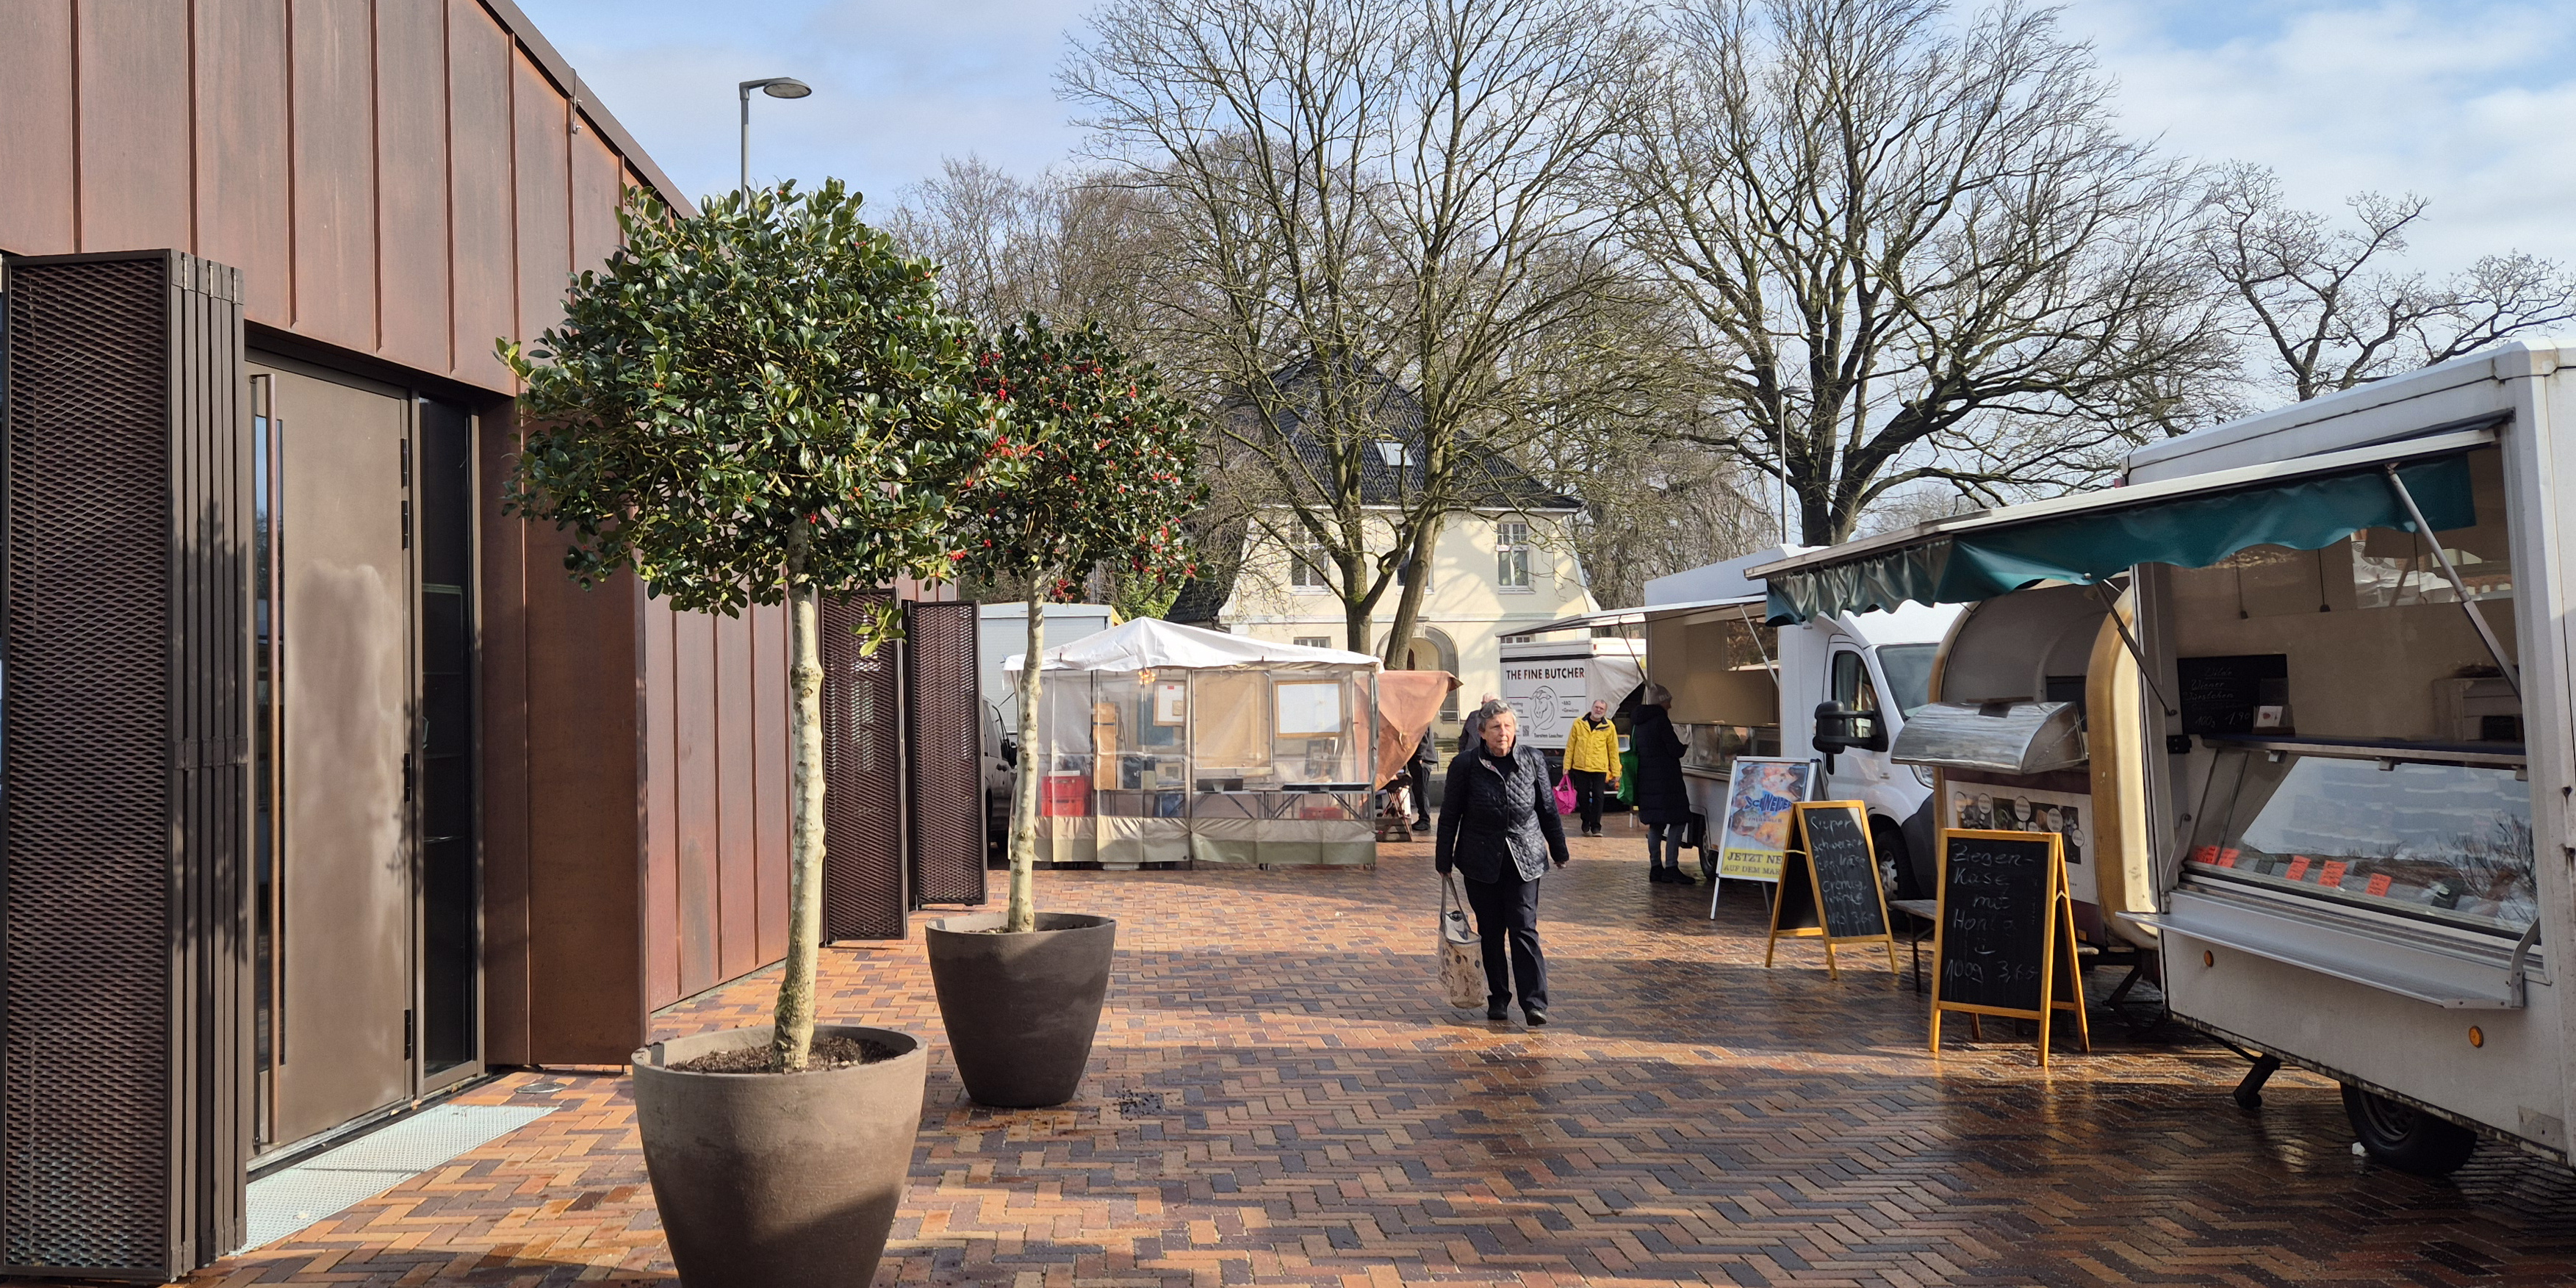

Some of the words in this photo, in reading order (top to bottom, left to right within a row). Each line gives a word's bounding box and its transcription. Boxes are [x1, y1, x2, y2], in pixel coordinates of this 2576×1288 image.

[1506, 669, 1522, 680] THE
[1524, 669, 1542, 680] FINE
[1544, 667, 1585, 679] BUTCHER
[1727, 852, 1763, 863] JETZT
[1766, 855, 1783, 864] NE
[1724, 864, 1740, 872] AUF
[1742, 866, 1760, 874] DEM
[1973, 886, 2011, 910] mit
[1946, 959, 1983, 983] 100g
